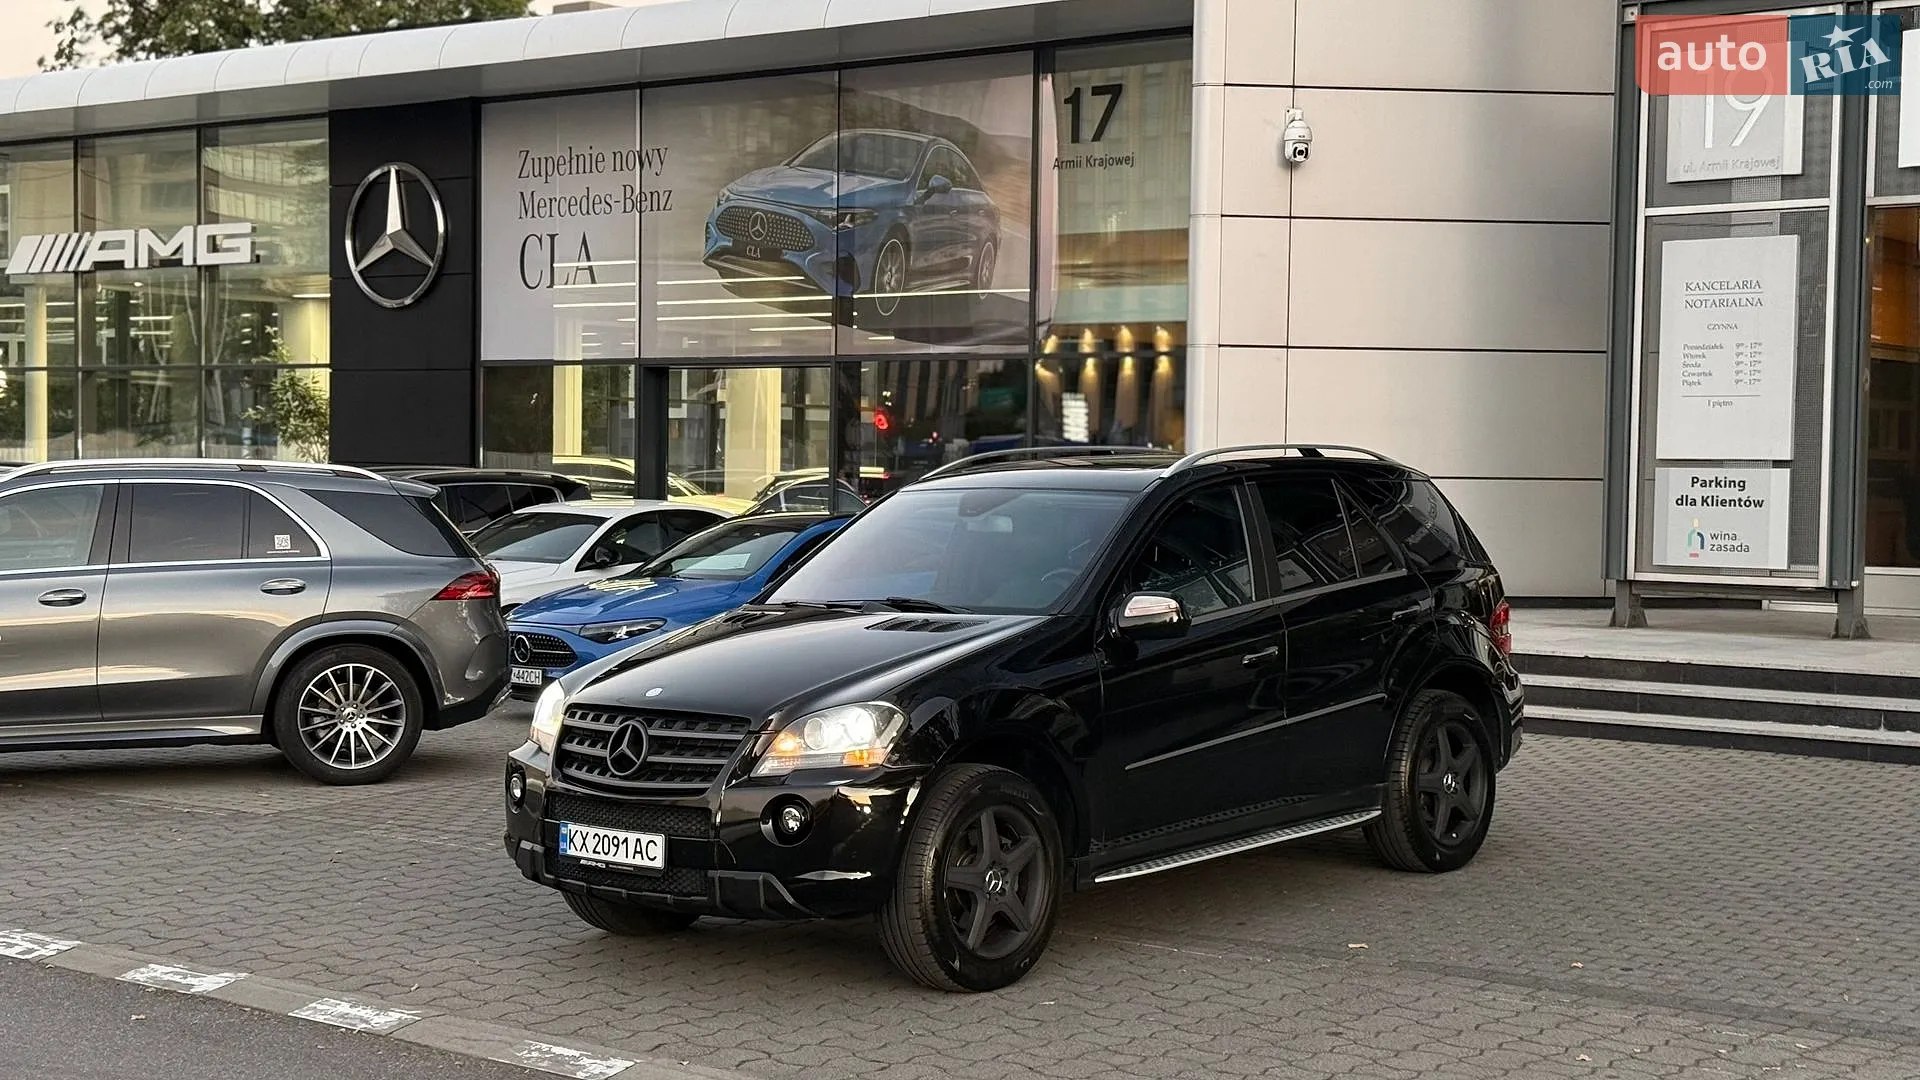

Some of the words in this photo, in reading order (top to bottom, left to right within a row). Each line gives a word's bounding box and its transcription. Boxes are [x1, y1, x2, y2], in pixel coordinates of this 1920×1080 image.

[1063, 83, 1123, 144] 17
[1697, 66, 1774, 149] 19
[518, 146, 605, 183] Zupełnie
[612, 147, 668, 176] nowy
[1053, 157, 1082, 170] Armii
[1086, 152, 1135, 170] Krajowej
[1731, 156, 1780, 171] Krajowej
[518, 184, 673, 220] Mercedes-Benz
[78, 222, 252, 272] AMG
[519, 231, 597, 290] CLA
[1684, 279, 1762, 292] KANCELARIA
[1684, 297, 1763, 309] NOTARIALNA
[1706, 322, 1739, 331] CZYNNA
[1691, 476, 1746, 491] Parking
[1675, 494, 1697, 507] dla
[1701, 495, 1765, 508] Klientów
[1710, 532, 1737, 541] wina
[1710, 543, 1750, 553] zasada
